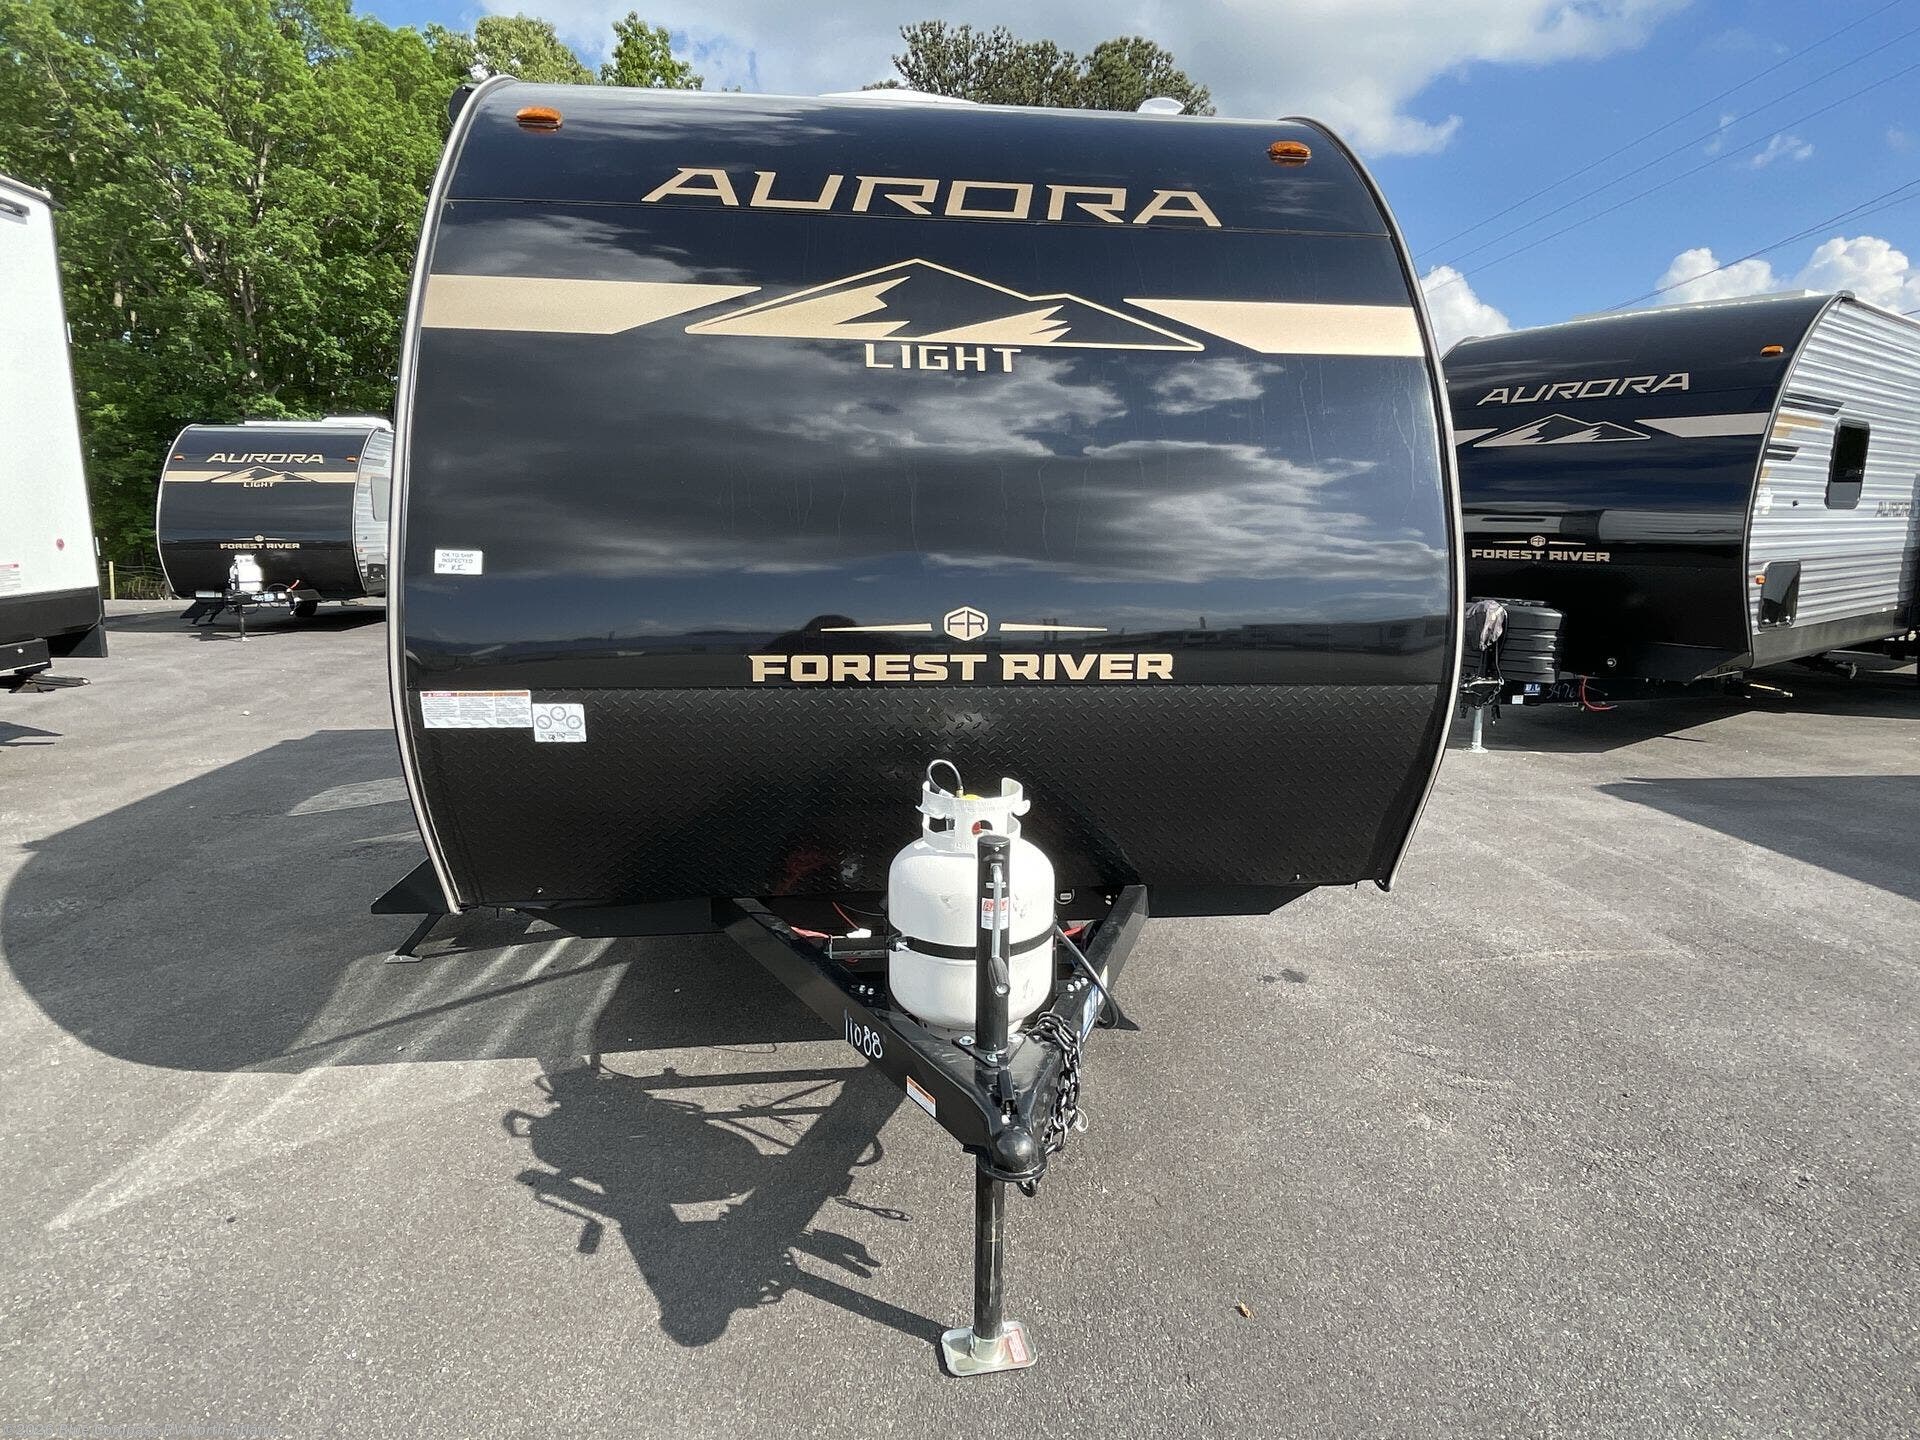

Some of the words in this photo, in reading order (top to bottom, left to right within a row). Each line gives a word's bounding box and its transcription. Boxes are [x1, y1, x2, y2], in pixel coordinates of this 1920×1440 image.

[641, 166, 1222, 228] AURORA
[864, 343, 1022, 374] LIGHT
[1476, 372, 1690, 406] AURORA
[206, 453, 325, 464] AURORA
[1471, 549, 1545, 560] FOREST
[1549, 551, 1610, 562] RIVER
[748, 654, 987, 682] FOREST
[1000, 653, 1174, 680] RIVER
